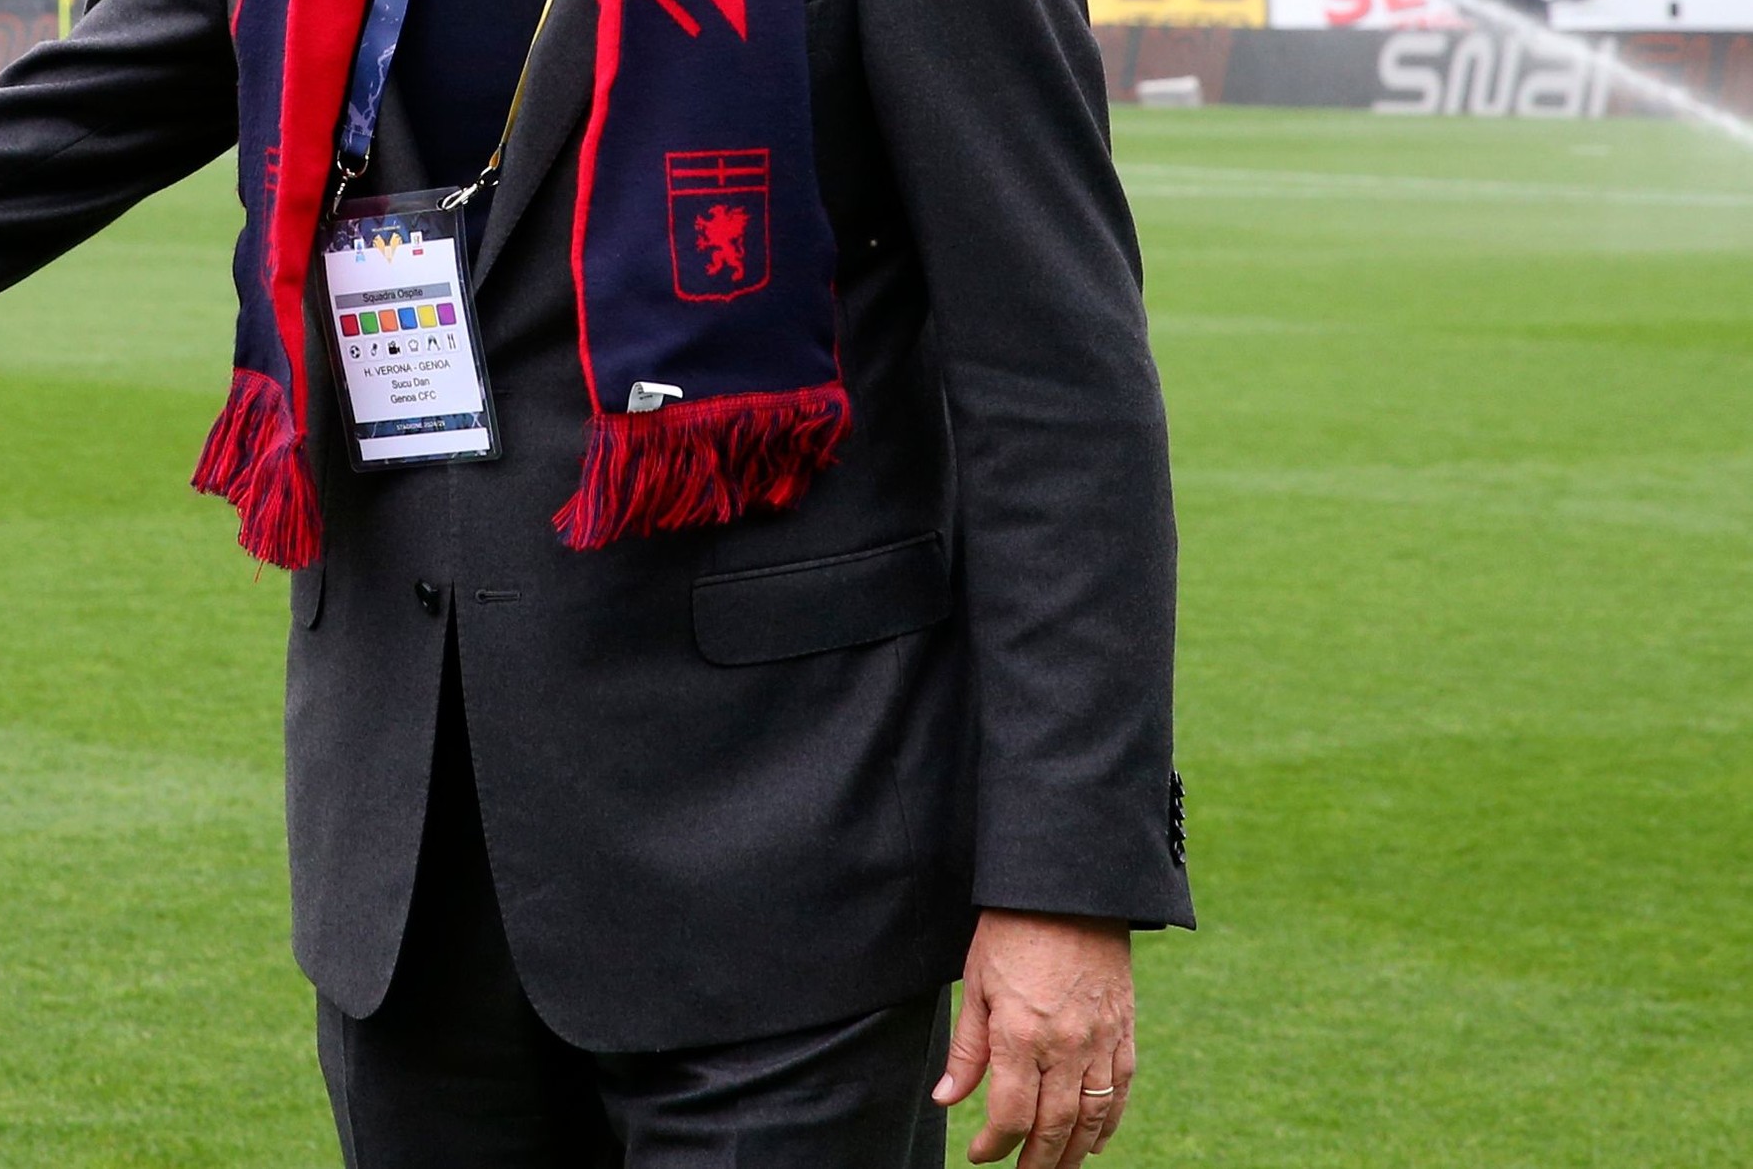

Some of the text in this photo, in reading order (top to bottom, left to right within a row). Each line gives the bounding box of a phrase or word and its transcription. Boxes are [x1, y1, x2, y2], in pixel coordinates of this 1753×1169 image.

[362, 287, 424, 303] Squadra Ospite
[364, 368, 374, 377] H.
[376, 363, 412, 375] VERONA
[419, 360, 450, 370] GENOA
[391, 377, 430, 390] Sucu Dan
[390, 391, 436, 404] Genoa CFC
